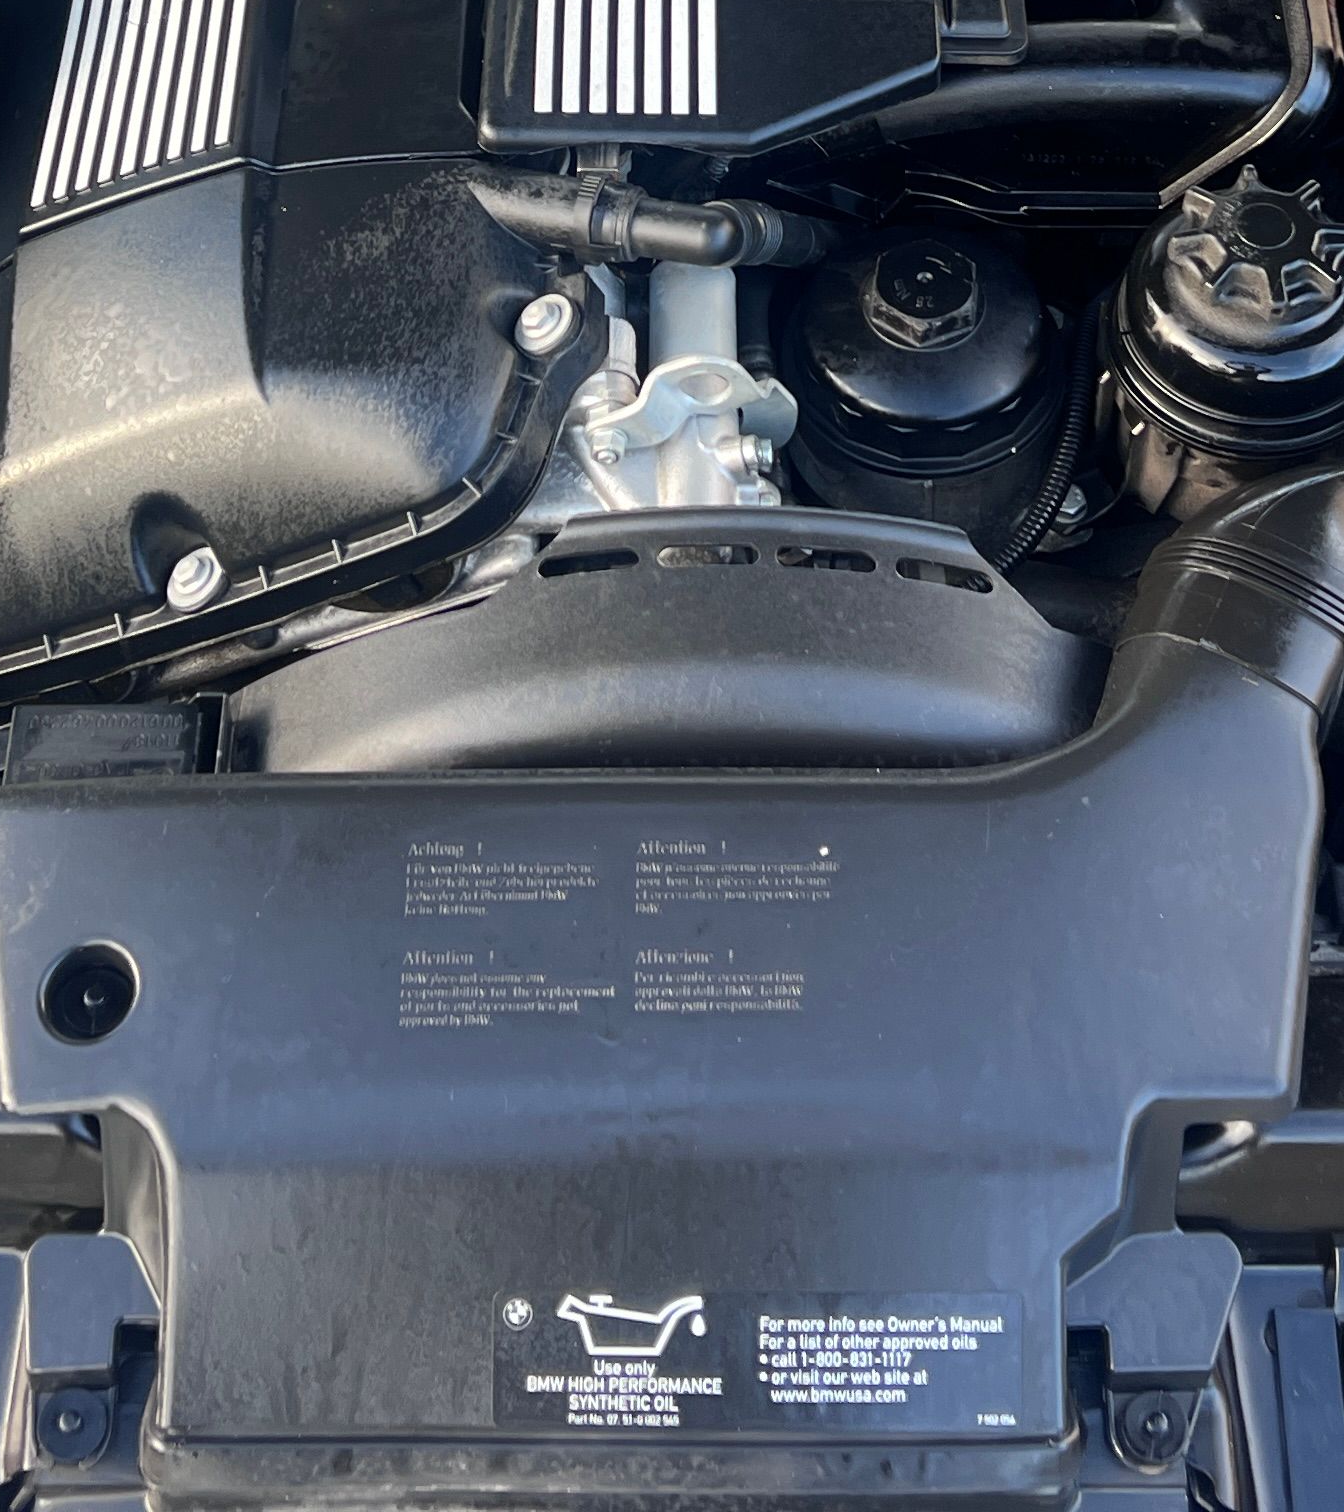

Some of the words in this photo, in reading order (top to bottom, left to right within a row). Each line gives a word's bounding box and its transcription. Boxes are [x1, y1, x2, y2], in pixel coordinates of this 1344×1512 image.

[408, 841, 464, 859] Achtung
[637, 840, 706, 855] Attention
[403, 950, 473, 966] Attention
[759, 1315, 785, 1333] For
[787, 1317, 826, 1333] more
[828, 1316, 856, 1333] info
[858, 1318, 884, 1333] see
[887, 1316, 947, 1333] Owner's
[950, 1316, 1003, 1333] Manual
[759, 1333, 785, 1350] For
[787, 1336, 796, 1350] a
[799, 1334, 821, 1350] list
[824, 1334, 840, 1350] of
[842, 1334, 880, 1350] other
[882, 1334, 949, 1352] approved
[951, 1334, 978, 1351] oils
[593, 1359, 622, 1376] Use
[624, 1360, 656, 1377] only
[771, 1351, 797, 1368] call
[801, 1351, 912, 1368] 1-800-831-1117
[526, 1375, 564, 1393] BMW
[568, 1376, 605, 1393] HIGH
[608, 1377, 724, 1395] PERFORMANCE
[771, 1371, 788, 1386] or
[790, 1369, 820, 1386] visit
[822, 1371, 848, 1386] our
[850, 1369, 881, 1386] web
[884, 1369, 910, 1386] site
[912, 1370, 929, 1386] at
[569, 1394, 651, 1412] SYNTHETIC
[653, 1395, 679, 1412] OIL
[770, 1387, 906, 1404] www.bmwusa.com
[567, 1413, 587, 1426] Part
